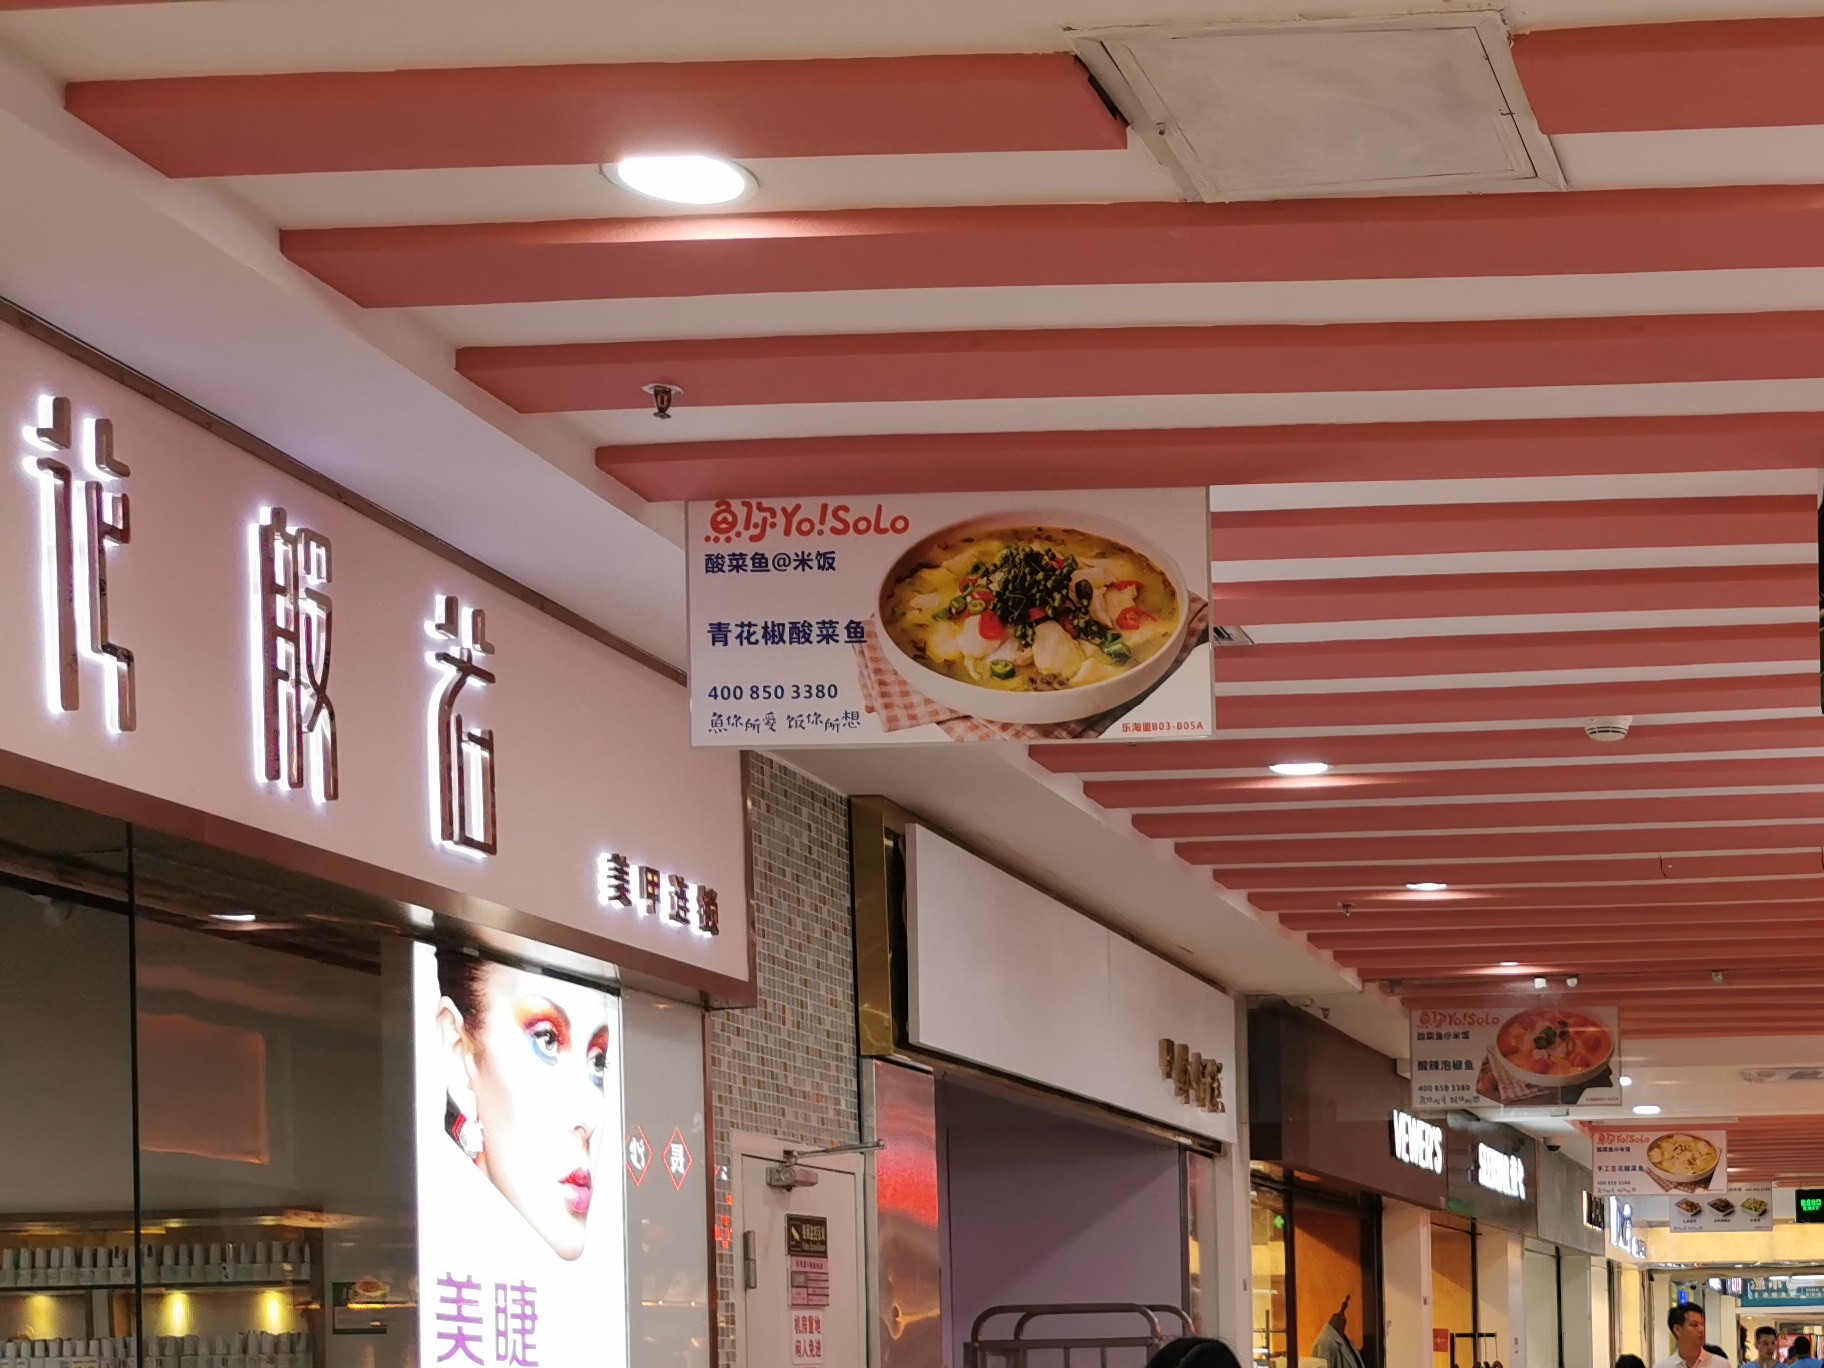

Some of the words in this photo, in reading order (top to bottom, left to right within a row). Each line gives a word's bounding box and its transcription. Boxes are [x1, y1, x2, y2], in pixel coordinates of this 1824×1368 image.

[704, 550, 837, 575] 酸菜鱼@米饭
[706, 619, 868, 647] 青花椒酸菜鱼
[708, 685, 744, 702] 400
[749, 684, 787, 701] 850
[790, 683, 839, 700] 3380
[436, 1271, 539, 1368] 美睫
